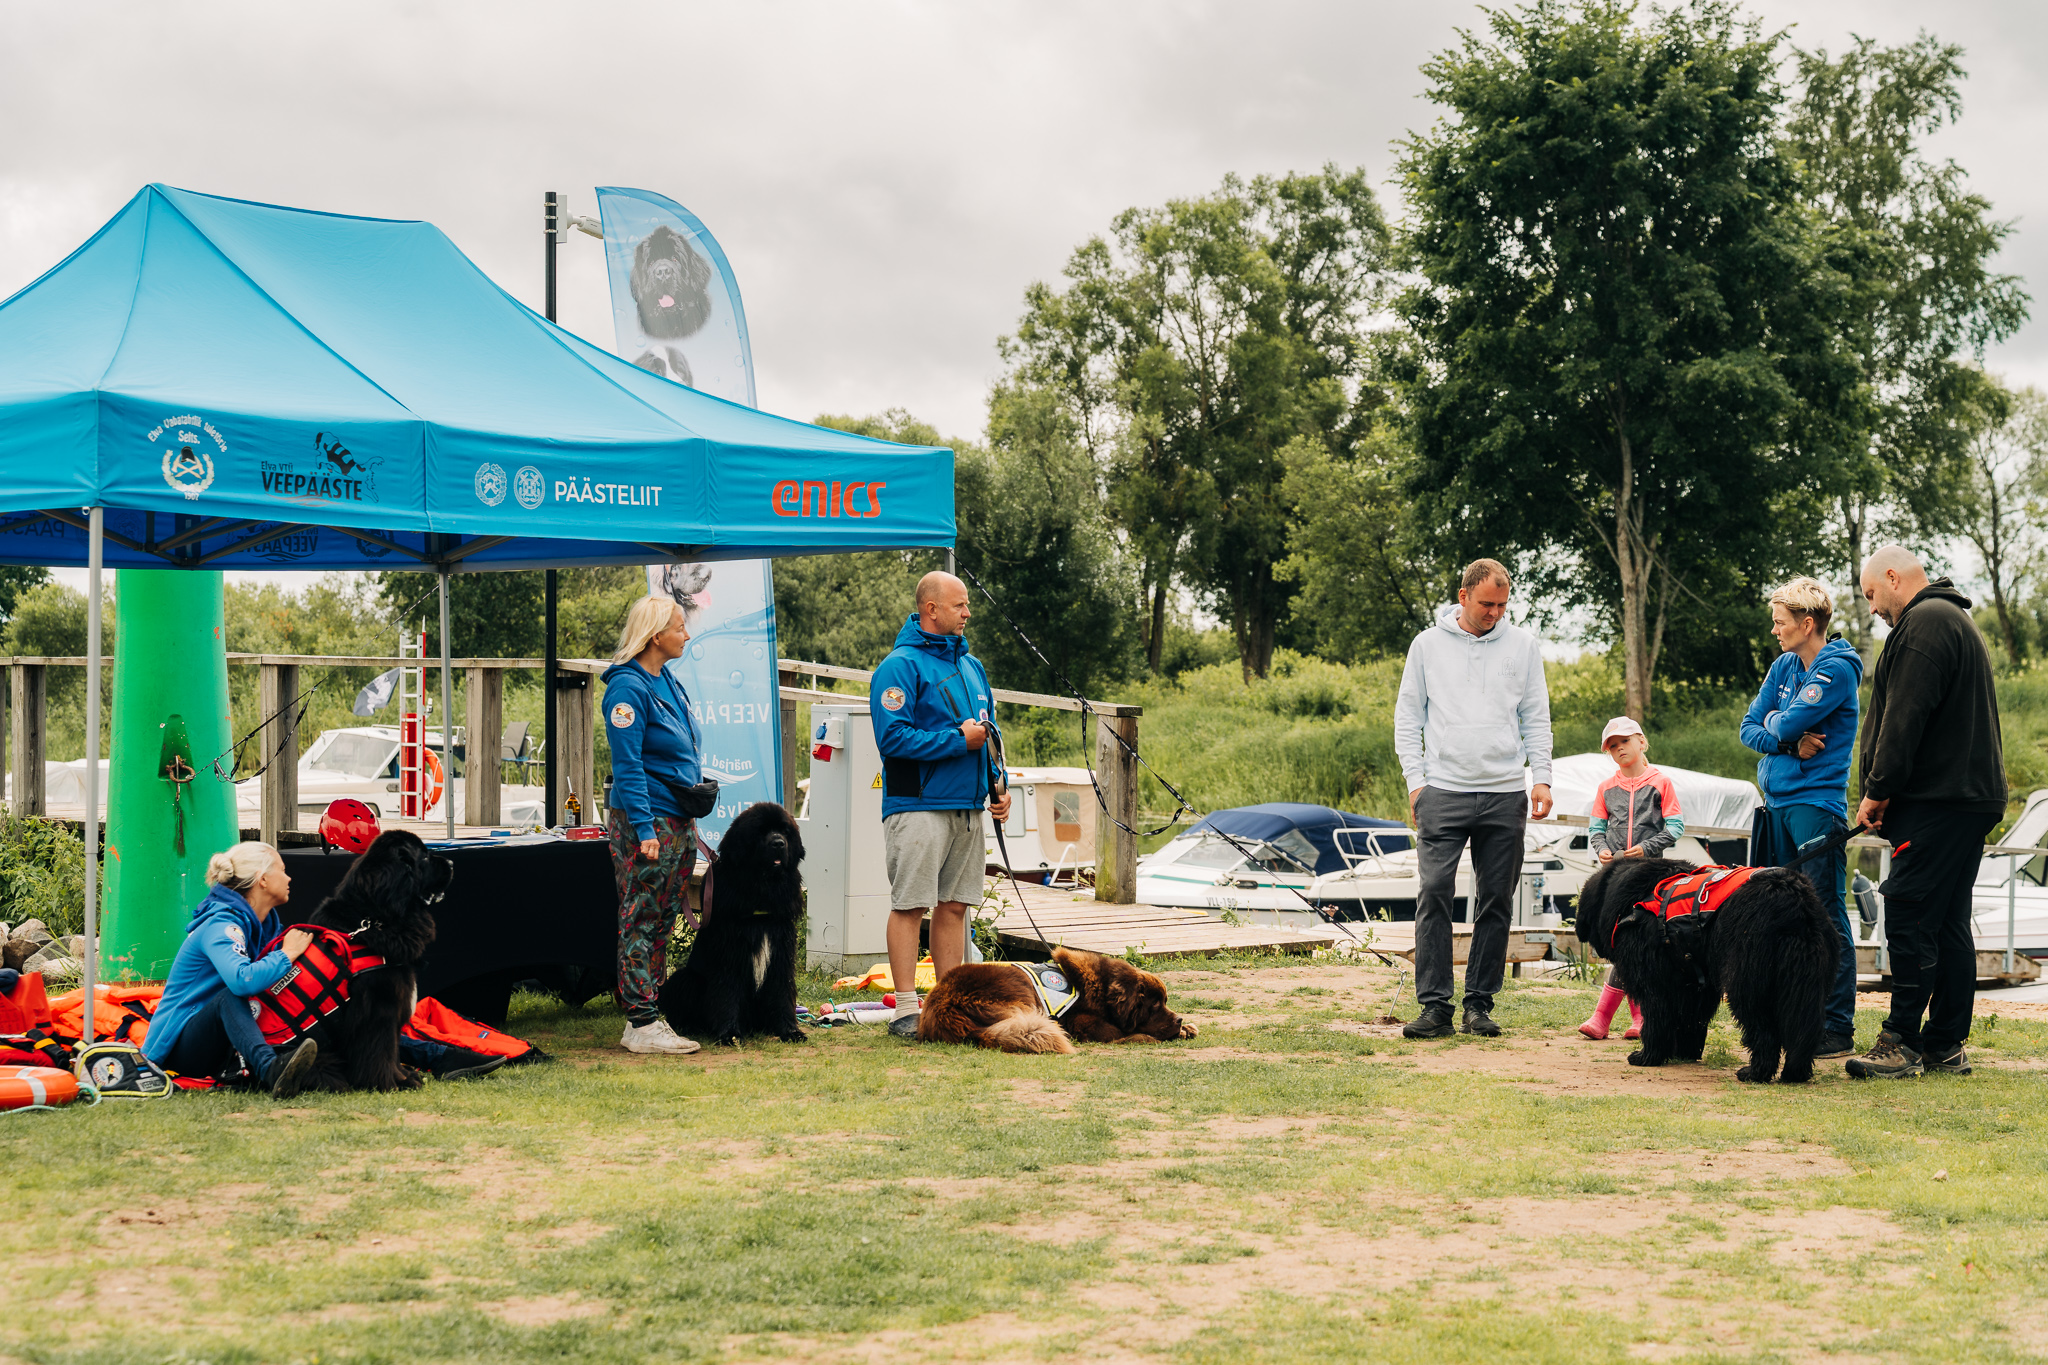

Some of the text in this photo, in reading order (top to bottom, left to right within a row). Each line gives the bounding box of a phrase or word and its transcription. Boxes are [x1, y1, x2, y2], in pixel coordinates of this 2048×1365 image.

[147, 426, 163, 442] Elva
[261, 460, 294, 473] Elva VTÜ
[261, 470, 363, 502] VEEPÄÄSTE
[554, 476, 663, 506] PÄÄSTELIIT
